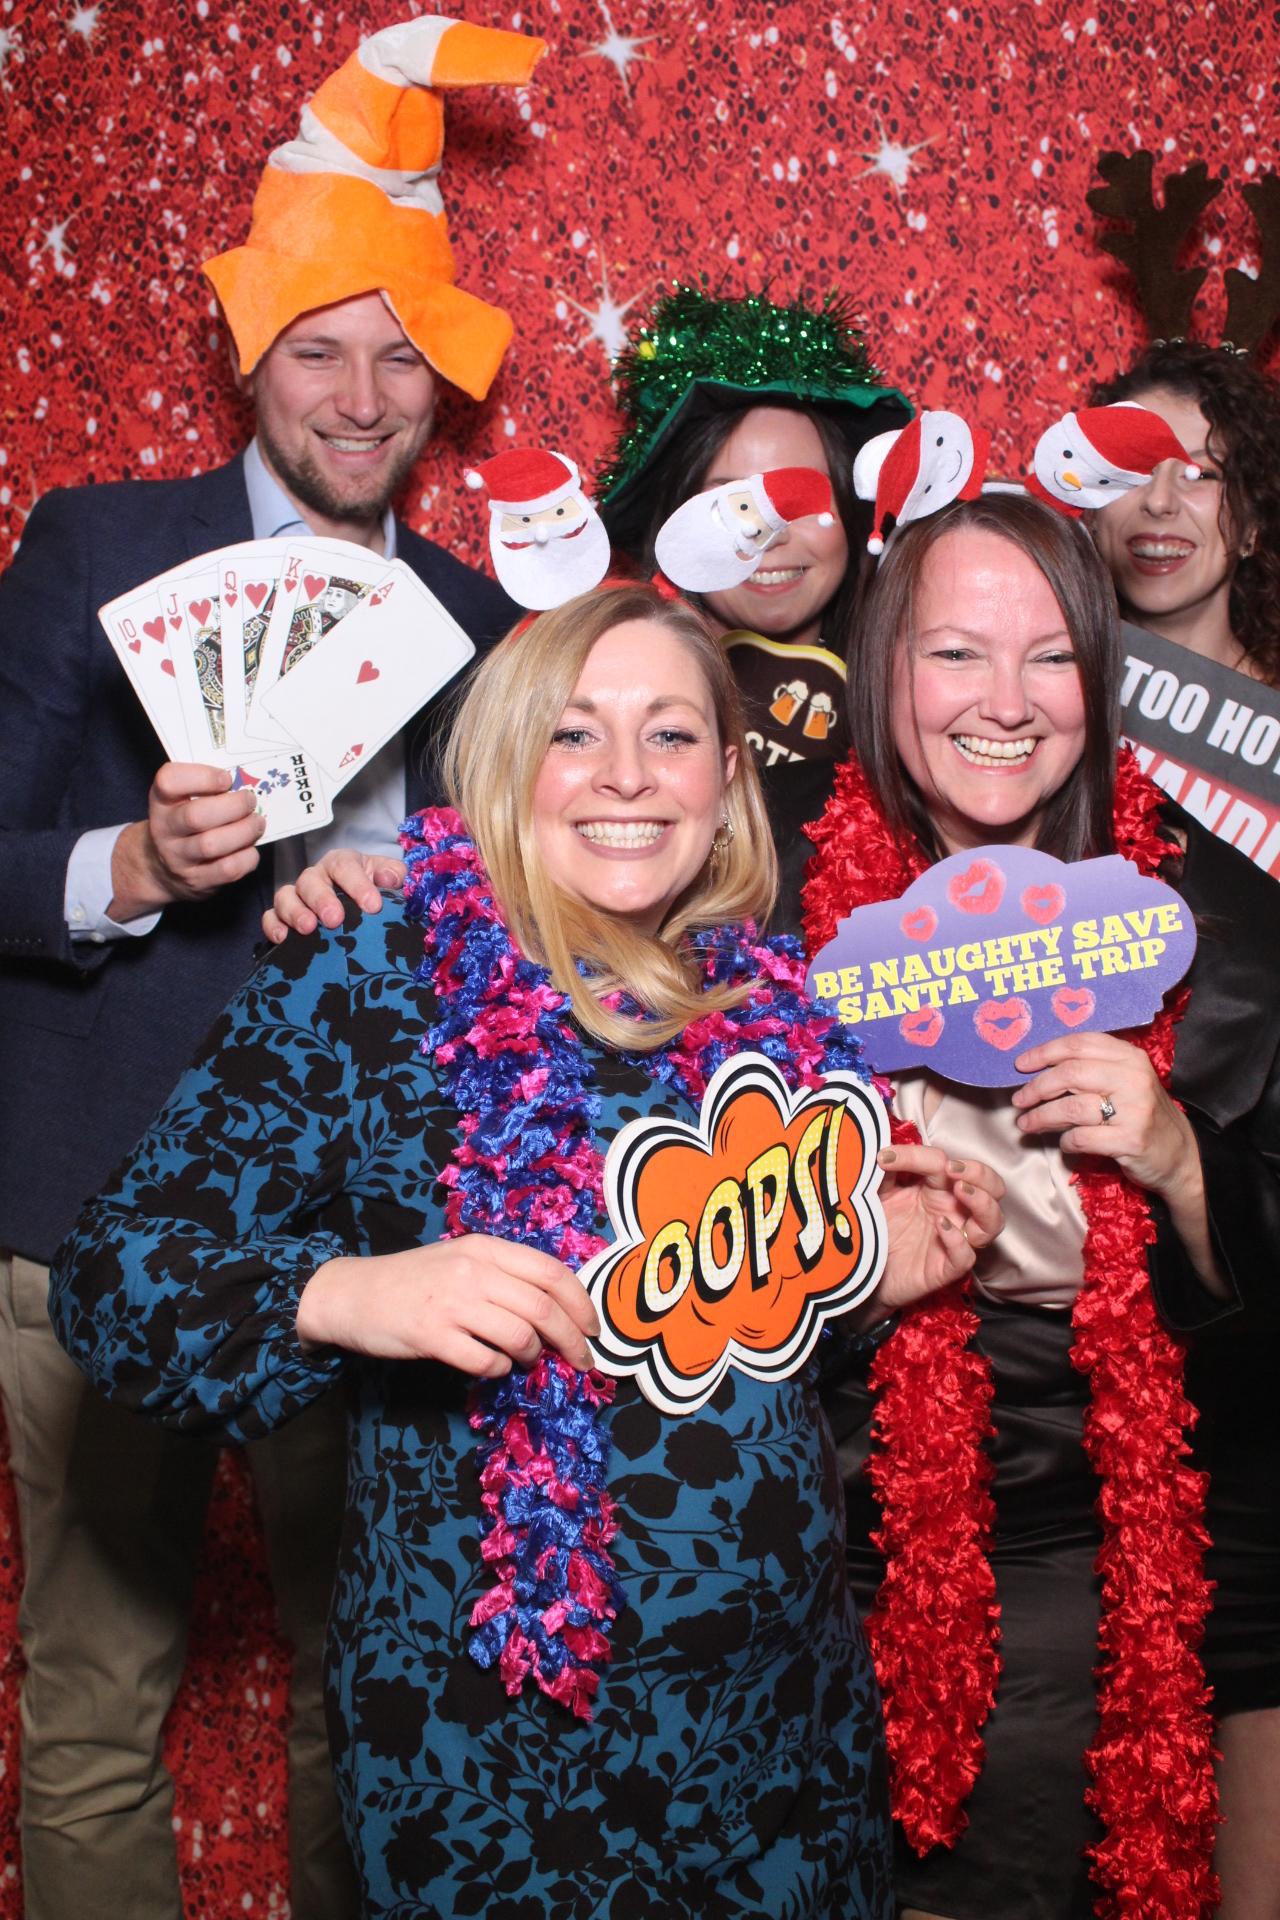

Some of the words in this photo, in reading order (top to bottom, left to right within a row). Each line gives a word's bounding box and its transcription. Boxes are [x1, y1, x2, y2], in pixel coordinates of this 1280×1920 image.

[284, 557, 302, 579] K
[224, 571, 238, 592] Q
[378, 581, 396, 599] A
[167, 592, 178, 615] J
[117, 618, 137, 641] 10
[1119, 655, 1210, 734] TOO
[1206, 698, 1280, 776] HO
[338, 751, 356, 768] A
[290, 753, 315, 815] JOKER
[813, 965, 864, 1000] BE
[869, 926, 1063, 990] NAUGHTY
[1071, 903, 1183, 951] SAVE
[836, 979, 979, 1024] SANTA
[983, 956, 1067, 997] THE
[1071, 938, 1167, 980] TRIP
[635, 1096, 853, 1324] OOPS!
